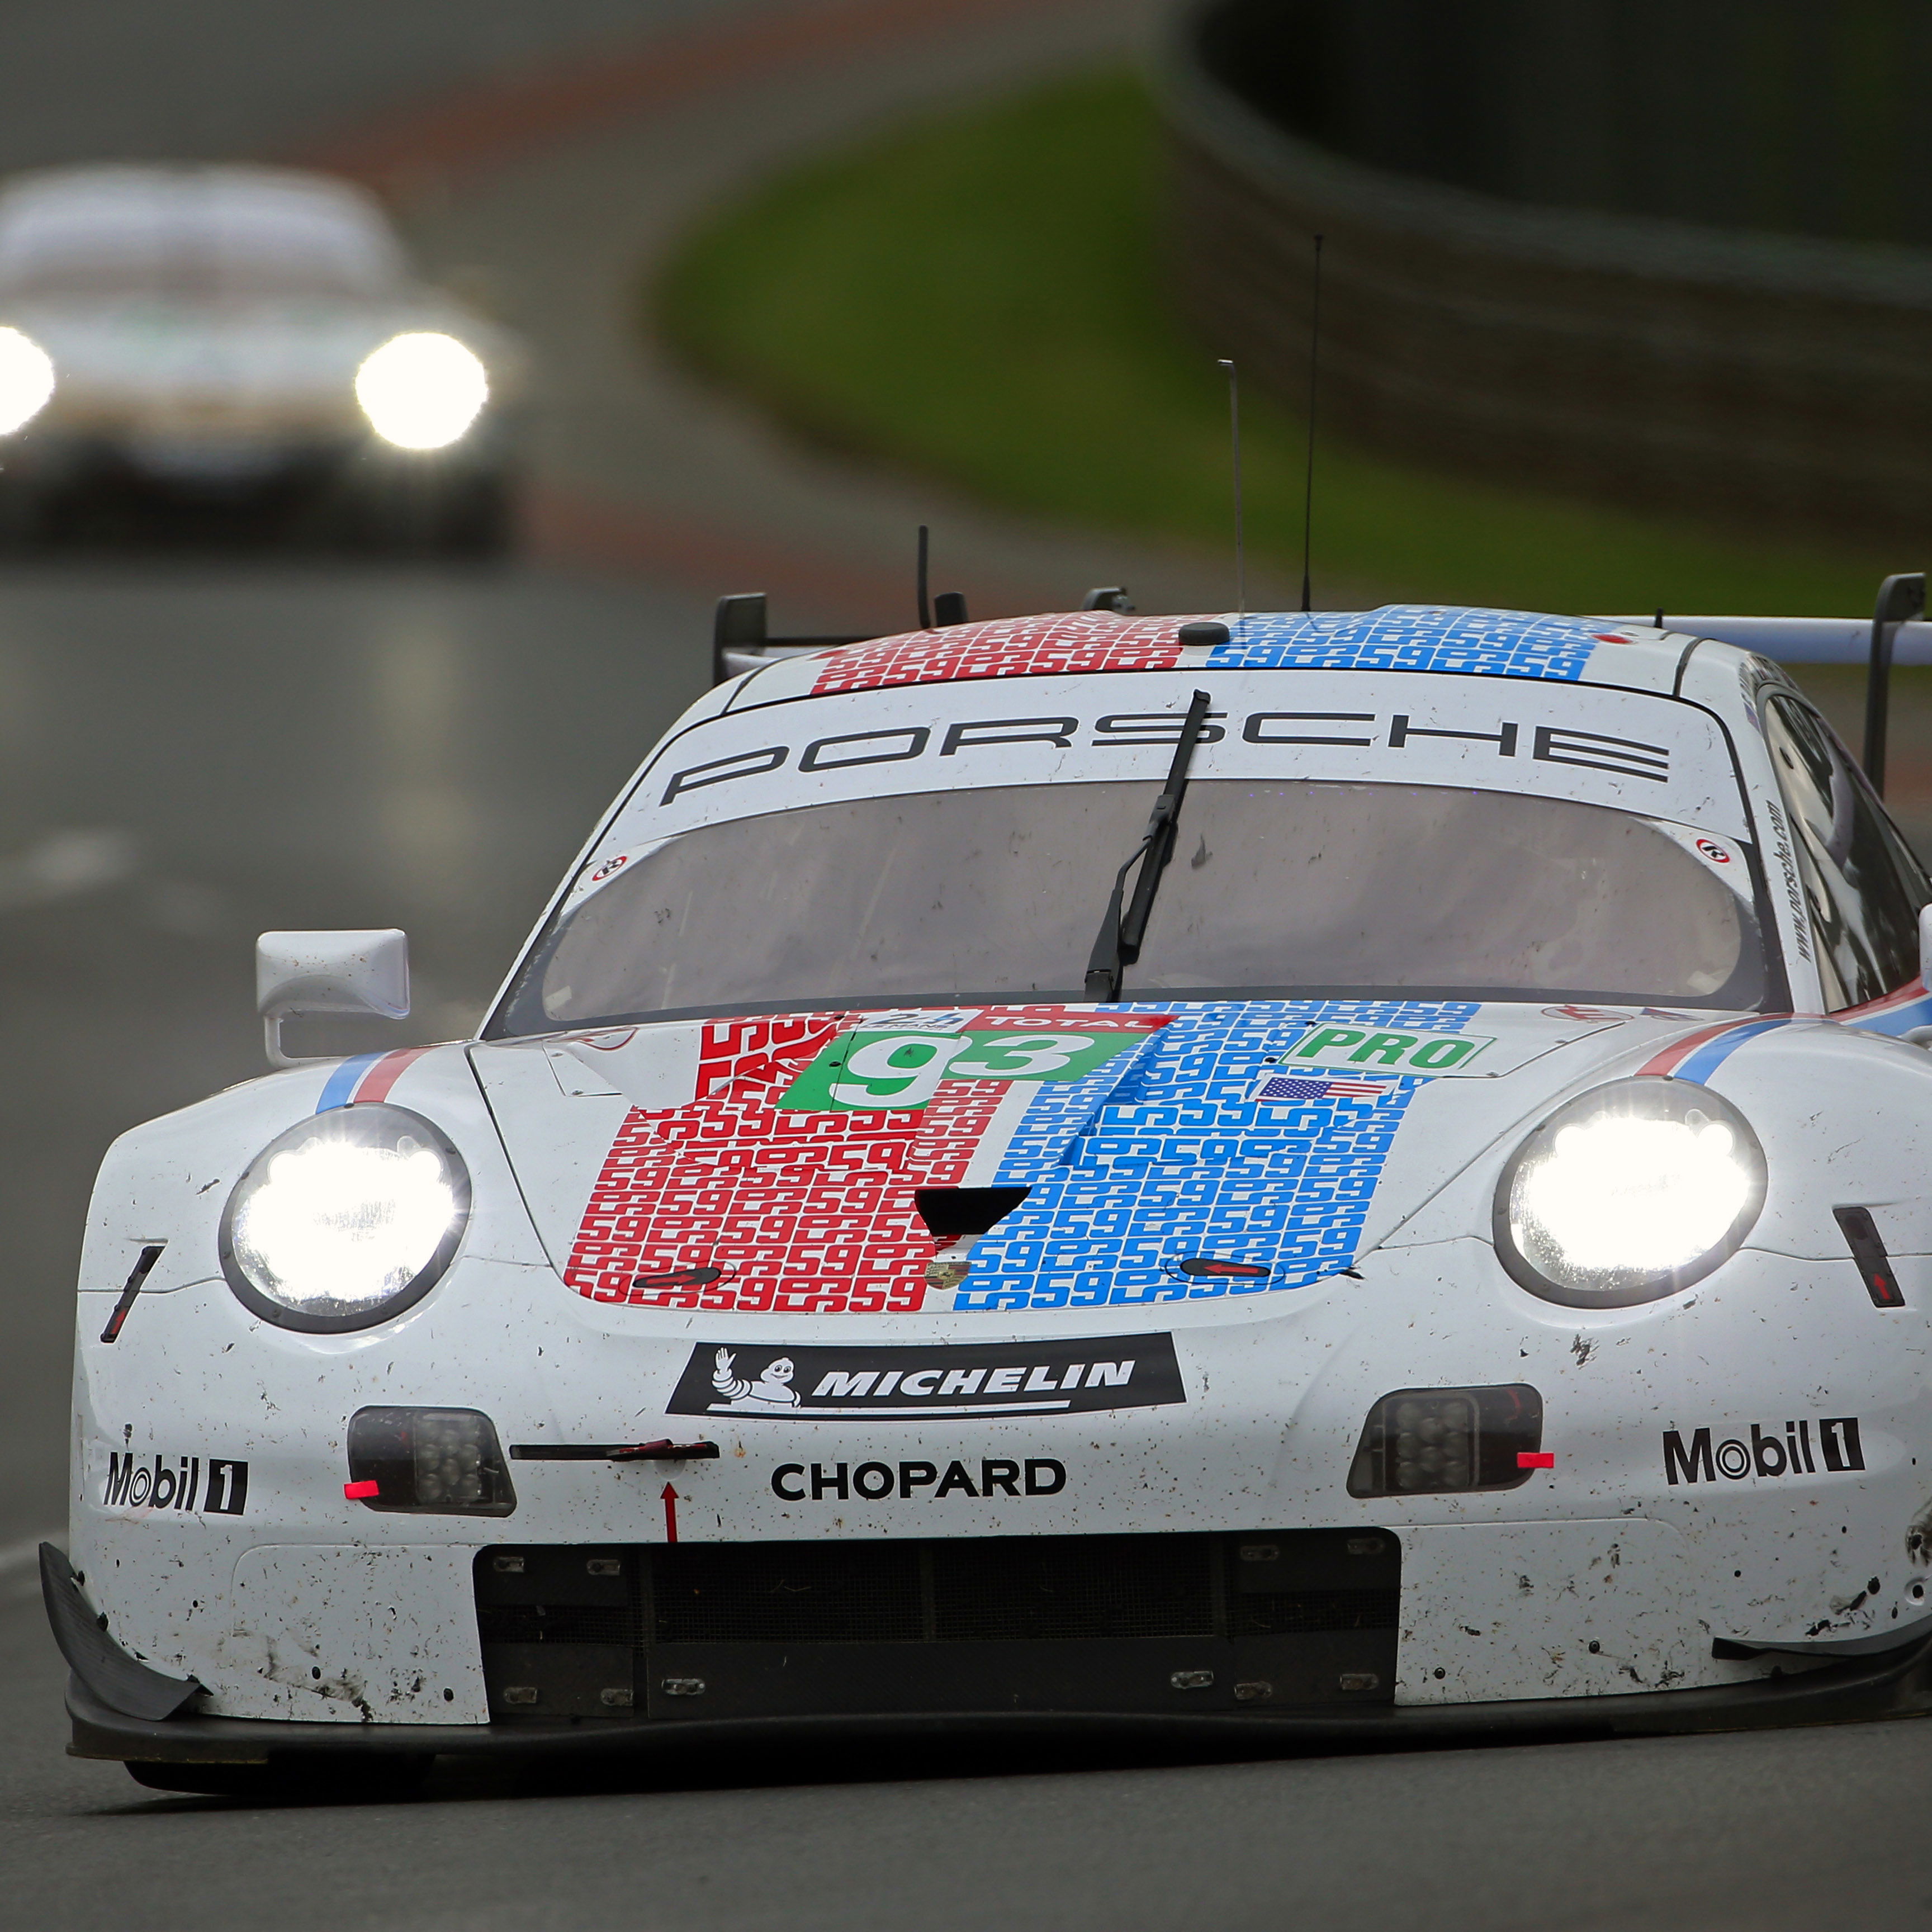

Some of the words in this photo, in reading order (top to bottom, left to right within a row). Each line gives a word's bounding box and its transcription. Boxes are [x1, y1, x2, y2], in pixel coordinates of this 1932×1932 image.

[1441, 629, 1519, 651] 59
[1030, 650, 1109, 673] 59
[1205, 646, 1286, 667] 59
[1356, 645, 1436, 670] 59
[1504, 652, 1586, 681] 59
[883, 657, 960, 685] 59
[660, 712, 1669, 807] PORSCHE
[1765, 799, 1811, 963] www.porsche.com
[986, 1016, 1153, 1027] TOTAL
[1294, 1027, 1474, 1068] PRO
[829, 1034, 1095, 1107] 93
[934, 1079, 1013, 1096] 59
[1026, 1094, 1109, 1114] 59
[918, 1116, 991, 1136] 59
[595, 1168, 670, 1190] 59
[1295, 1177, 1378, 1202] 59
[657, 1190, 733, 1215] 59
[803, 1187, 883, 1214] 59
[1138, 1180, 1220, 1207] 59
[577, 1216, 651, 1242] 59
[718, 1216, 797, 1243] 59
[1050, 1209, 1133, 1239] 59
[1207, 1205, 1290, 1234] 59
[966, 1241, 1045, 1273] 59
[1278, 1227, 1362, 1259] 59
[784, 1245, 862, 1276] 59
[849, 1277, 927, 1312] 59
[1031, 1271, 1114, 1308] 59
[812, 1359, 1135, 1397] MICHELIN
[1662, 1420, 1816, 1485] Mobil
[104, 1452, 199, 1511] Mobil
[771, 1458, 1067, 1502] CHOPARD
